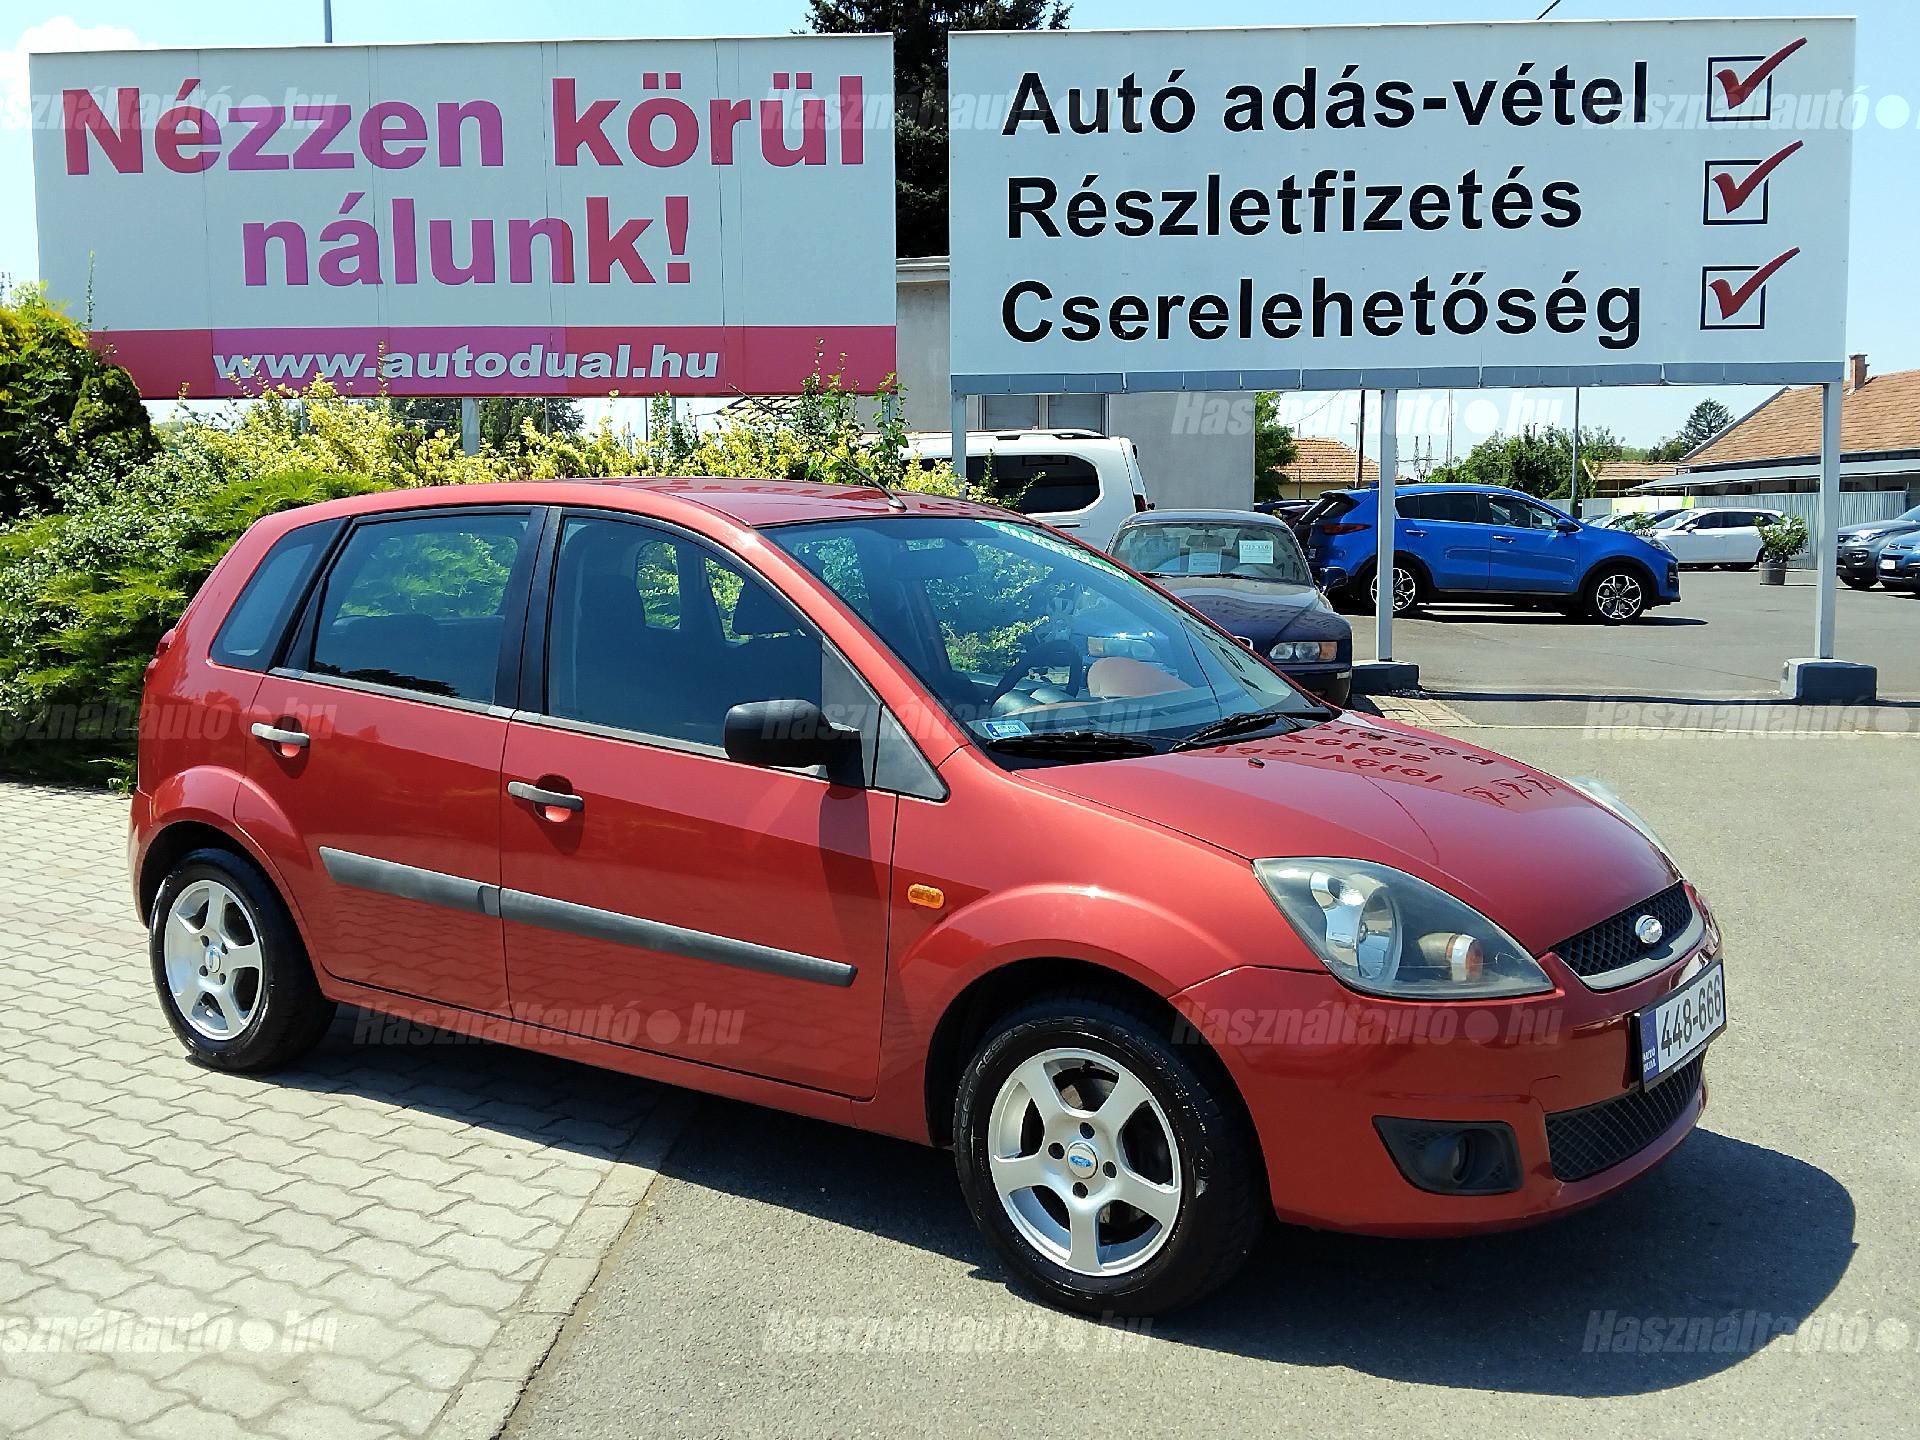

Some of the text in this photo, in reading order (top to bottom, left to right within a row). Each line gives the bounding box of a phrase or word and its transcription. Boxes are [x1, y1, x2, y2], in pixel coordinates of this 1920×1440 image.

[63, 73, 864, 176] Nézzen körül
[1002, 60, 1648, 136] Autó adás-vétel
[244, 192, 691, 287] nálunk!
[1008, 164, 1582, 240] Részletfizetés
[1003, 268, 1640, 350] Cserelehetőség
[214, 344, 719, 380] www.autodual.hu
[1661, 974, 1721, 1057] 448-666
